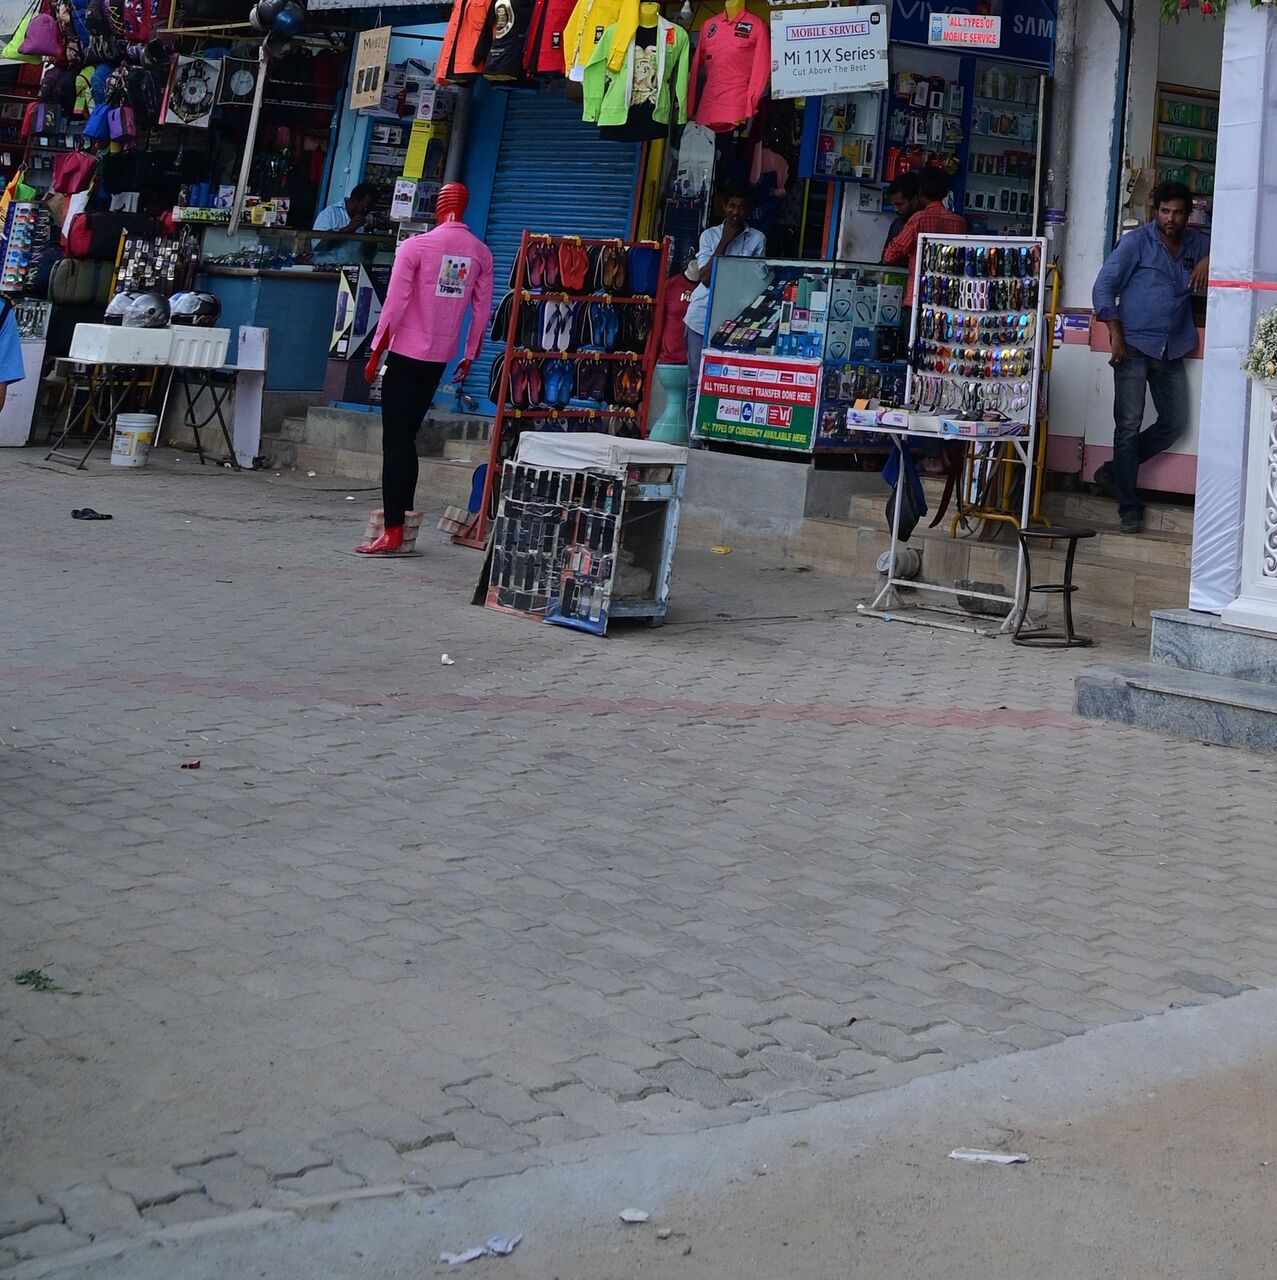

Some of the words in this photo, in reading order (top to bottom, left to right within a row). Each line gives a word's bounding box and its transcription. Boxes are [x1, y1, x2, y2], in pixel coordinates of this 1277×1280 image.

[950, 17, 962, 26] ALL
[964, 18, 984, 28] TYPES
[986, 19, 994, 28] OF
[791, 28, 826, 38] MOBILE
[829, 24, 866, 35] SERVICE
[944, 32, 967, 42] MOBILE
[970, 32, 996, 43] SERVICE
[785, 51, 800, 65] Mi
[805, 49, 831, 64] 11X
[835, 47, 875, 62] Series
[809, 67, 831, 75] Above
[704, 381, 713, 391] ALL
[713, 383, 728, 392] TYPES
[730, 384, 736, 393] OF
[737, 385, 753, 395] MONEY
[755, 387, 781, 399] TRANSFER
[782, 390, 797, 400] DONE
[797, 392, 811, 402] HERE
[724, 405, 739, 416] airtel
[712, 423, 727, 433] TYPES
[728, 425, 735, 433] OF
[736, 426, 763, 437] CURRENCY
[763, 429, 791, 440] AVAILABLE
[792, 433, 808, 443] HERE
